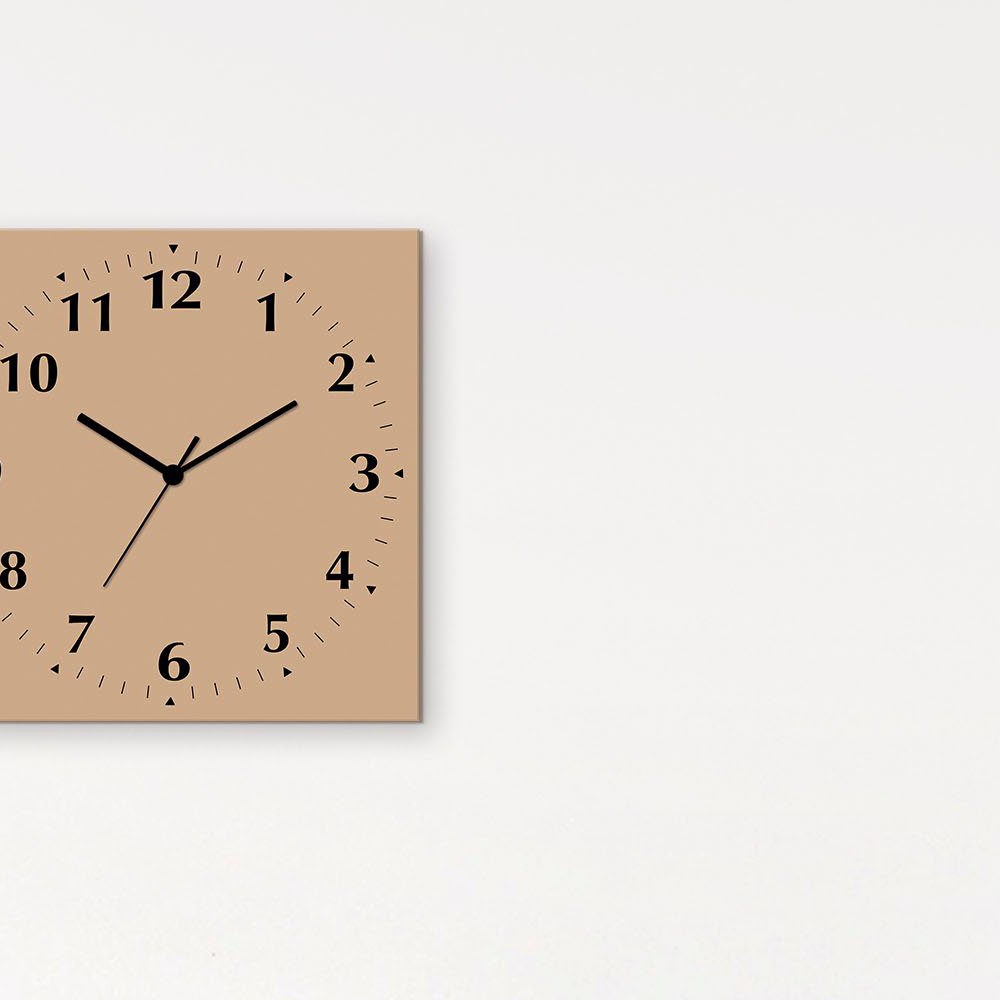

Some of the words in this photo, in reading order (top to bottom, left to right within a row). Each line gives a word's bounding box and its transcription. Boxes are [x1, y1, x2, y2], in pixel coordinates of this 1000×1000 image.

[142, 269, 201, 310] 12
[60, 292, 112, 332] 11
[256, 292, 277, 332] 1
[0, 352, 59, 393] 10
[328, 352, 355, 392] 2
[348, 453, 380, 493] 3
[325, 550, 354, 590] 4
[67, 614, 96, 654] 7
[263, 613, 290, 654] 5
[157, 641, 191, 682] 6
